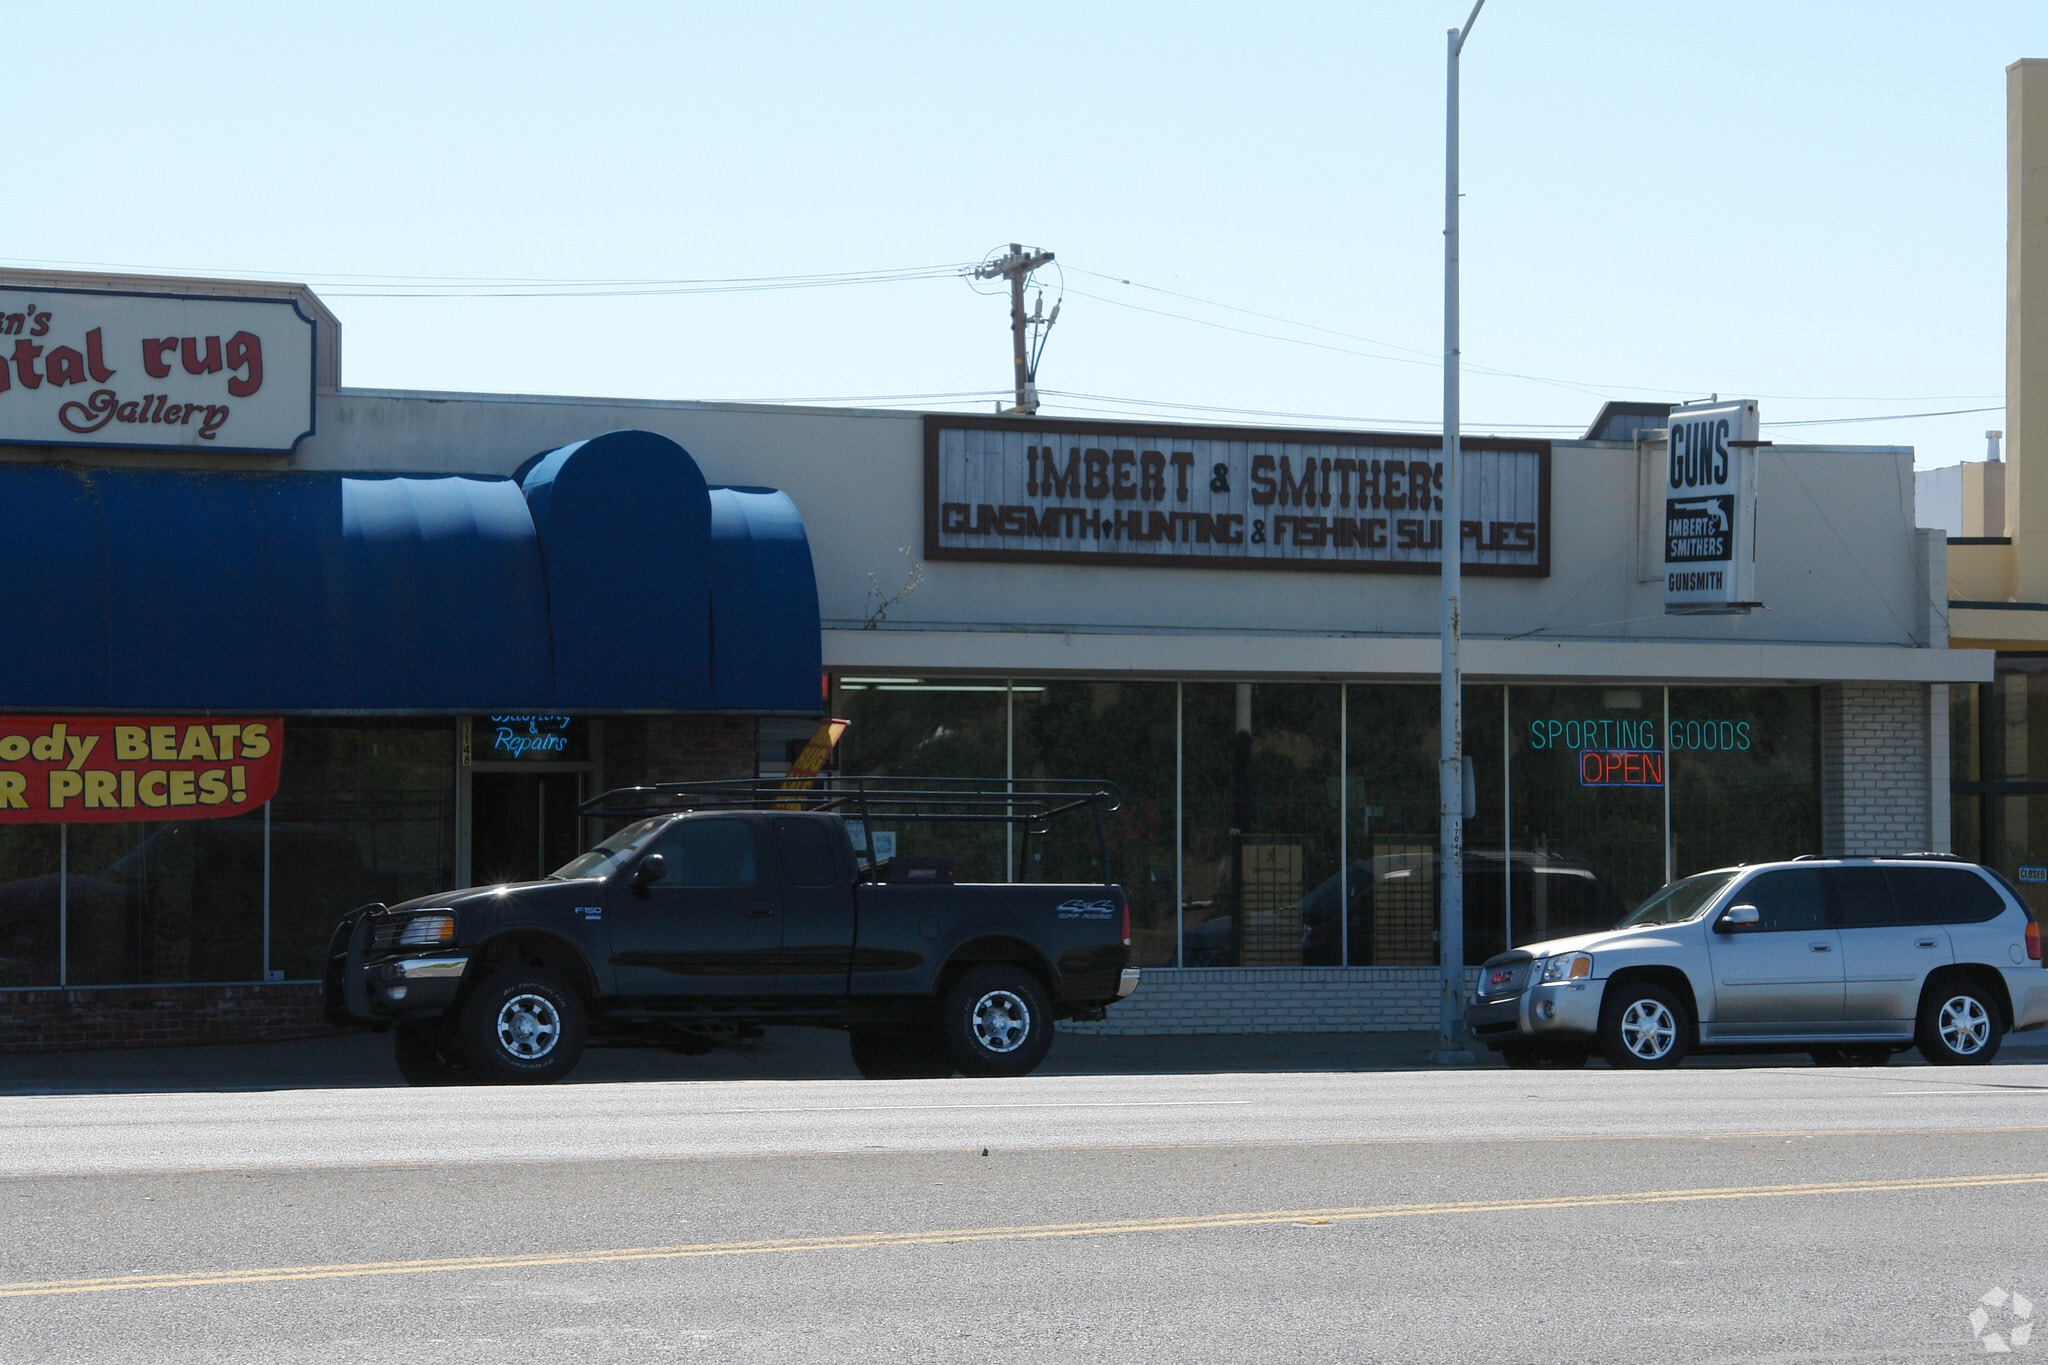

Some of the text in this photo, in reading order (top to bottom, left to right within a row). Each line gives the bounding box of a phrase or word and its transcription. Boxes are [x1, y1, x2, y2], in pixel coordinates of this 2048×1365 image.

[142, 330, 264, 398] rug
[58, 389, 230, 440] Gallery
[1670, 419, 1730, 489] GUNS
[1027, 445, 1195, 503] IMBERT
[1210, 463, 1230, 493] &
[942, 502, 1536, 551] GUNSMITH HUNTING & FISHING SUPLIES
[1668, 518, 1716, 537] IMBERT &
[1670, 537, 1724, 557] SMITHERS
[1668, 571, 1723, 592] GUNSMITH
[114, 723, 271, 761] BEATS
[494, 726, 568, 759] Repairs
[529, 720, 539, 734] &
[1531, 720, 1751, 751] SPORTING GOODS
[793, 746, 828, 773] RUG
[1582, 752, 1663, 784] OPEN
[49, 765, 248, 809] PRICES!
[2019, 869, 2047, 880] CLOSED
